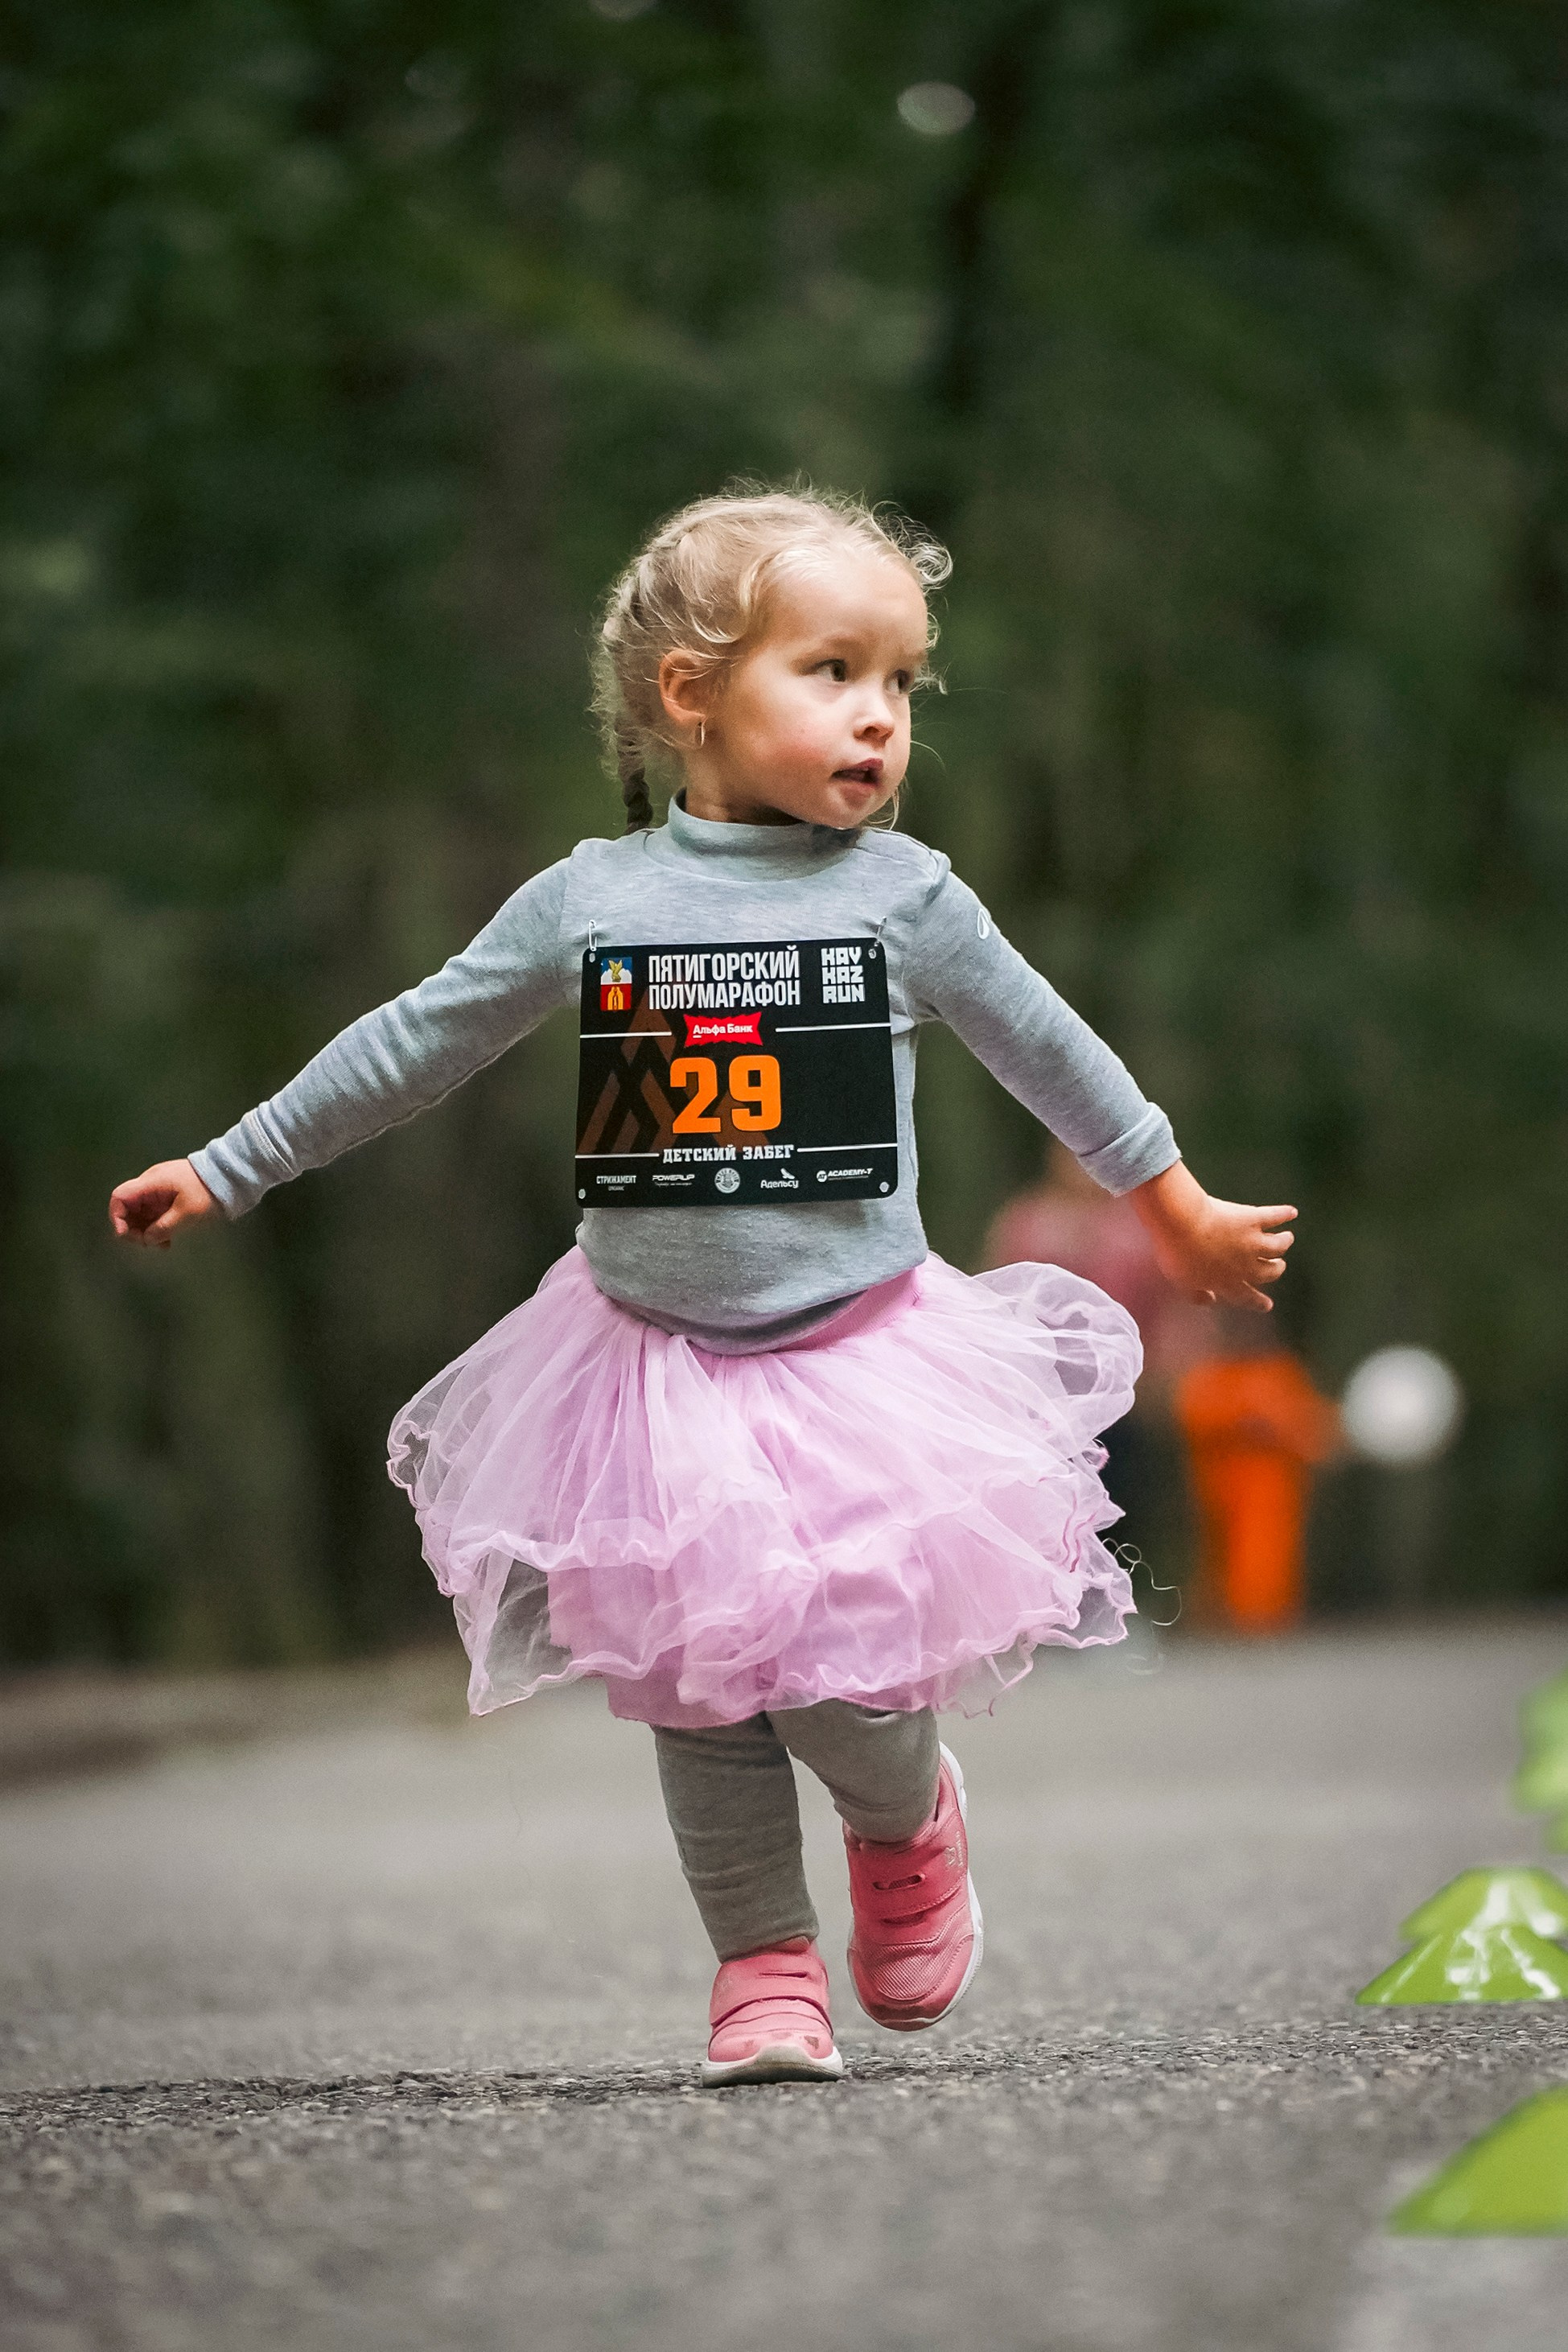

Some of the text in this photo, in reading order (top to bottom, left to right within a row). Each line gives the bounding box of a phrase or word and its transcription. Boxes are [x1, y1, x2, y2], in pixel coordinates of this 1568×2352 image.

[648, 945, 800, 982] ПЯТИГОРСКИЙ
[821, 946, 862, 966] KAV
[822, 966, 863, 984] KAZ
[648, 980, 800, 1010] ПОЛУМАРАФОН
[823, 984, 865, 1003] RUN
[693, 1024, 753, 1038] Альфа Банк
[669, 1055, 781, 1134] 29
[663, 1144, 794, 1164] ДЕТСКИЙ ЗАБЕГ
[596, 1175, 636, 1184] СТРИЖАМЕНТ
[760, 1180, 799, 1188] Адельсу
